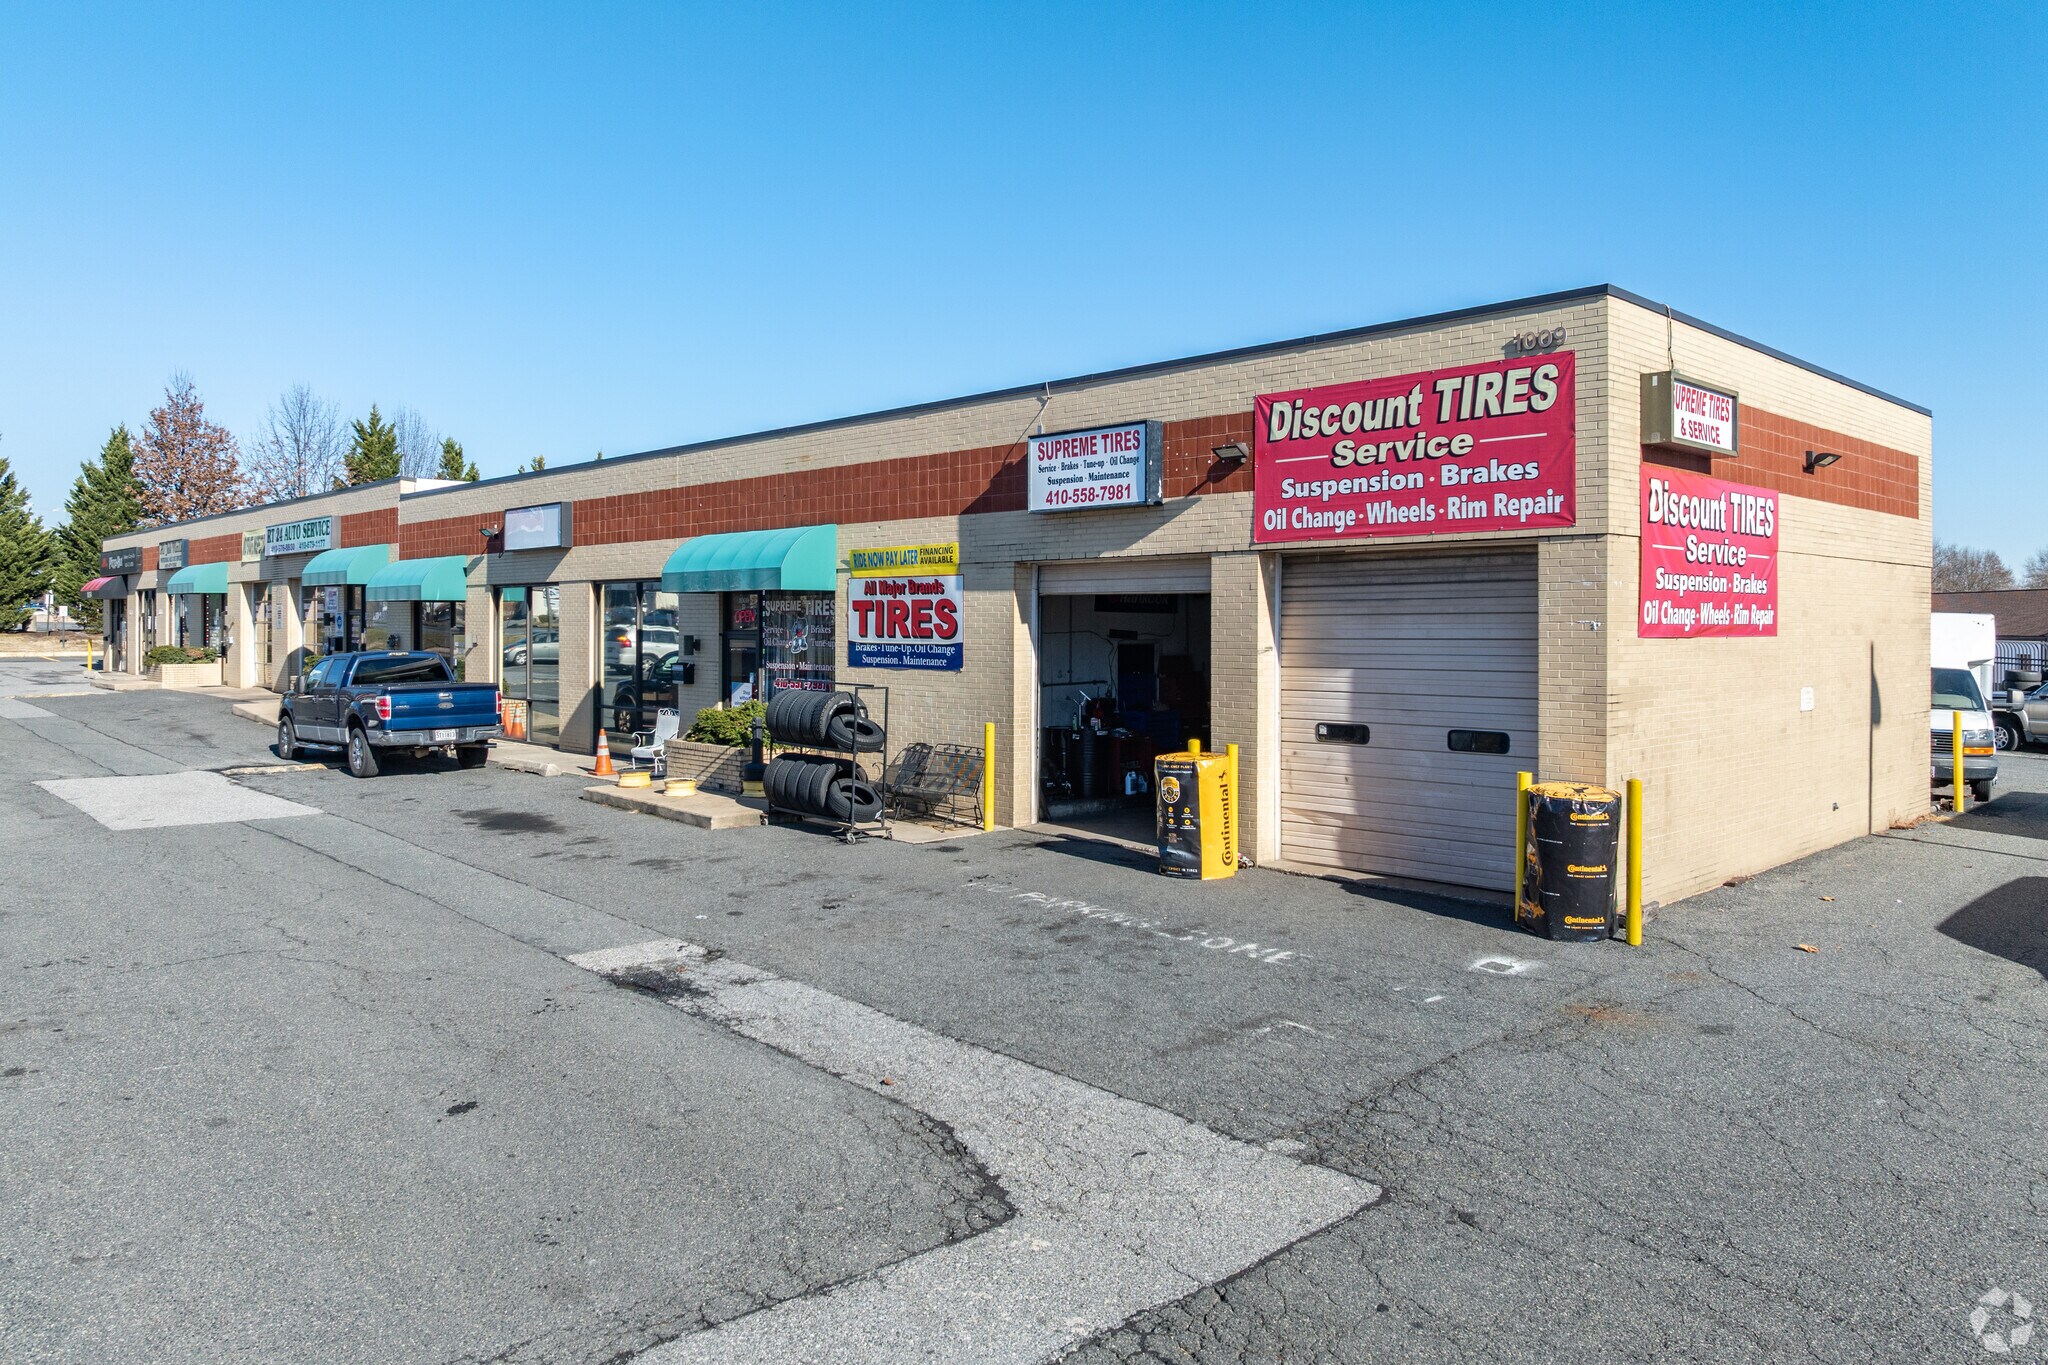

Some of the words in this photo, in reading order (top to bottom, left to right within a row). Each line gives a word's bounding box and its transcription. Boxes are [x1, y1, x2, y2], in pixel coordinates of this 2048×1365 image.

[1513, 326, 1568, 354] 1009
[1268, 382, 1424, 443] Discount
[1435, 364, 1560, 424] TIRES
[1674, 384, 1708, 417] UPREME
[1708, 394, 1730, 423] TIRES
[1680, 417, 1687, 437] &
[1688, 420, 1721, 445] SERVICE
[1037, 434, 1098, 462] SUPREME
[1101, 429, 1141, 454] TIRES
[1332, 431, 1475, 468] Service
[1037, 463, 1057, 474] Service
[1060, 460, 1079, 472] Brakes
[1083, 459, 1105, 470] Tune-up
[1109, 455, 1118, 467] Oil
[1119, 454, 1140, 467] Change
[1047, 473, 1084, 487] Suspension
[1088, 470, 1130, 483] Maintenance
[1281, 468, 1425, 502] Suspension
[1440, 458, 1540, 487] Brakes
[1045, 483, 1131, 506] 410-558-7981
[1263, 508, 1287, 532] Oil
[1291, 504, 1356, 534] Change
[1366, 497, 1436, 526] Wheels
[1447, 494, 1487, 520] Rim
[1493, 488, 1565, 524] Repair
[1648, 477, 1727, 533] Discount
[1729, 492, 1775, 538] TIRES
[275, 527, 283, 542] 24
[284, 524, 301, 541] AUTO
[302, 519, 330, 539] SERVICE
[852, 552, 867, 569] RIDE
[868, 551, 884, 567] NOW
[885, 550, 899, 567] PAY
[899, 549, 919, 566] LATER
[919, 546, 954, 556] FINANCING
[920, 555, 954, 565] AVAILABLE
[1685, 534, 1747, 568] Service
[863, 580, 878, 596] All
[878, 580, 907, 599] Major
[907, 578, 945, 596] Brands
[1655, 567, 1727, 597] Suspension
[1732, 572, 1768, 595] Brakes
[734, 609, 756, 623] OPEN
[765, 599, 802, 617] SUPREME
[805, 599, 835, 616] TIRES
[852, 598, 959, 640] TIRES
[1643, 599, 1659, 626] Oil
[1660, 600, 1696, 632] Change
[1700, 601, 1731, 626] Wheels
[1733, 603, 1750, 626] Rim
[1751, 603, 1775, 632] Repair
[763, 625, 784, 634] Service
[810, 624, 832, 634] Brakes
[855, 643, 877, 652] Brakes
[880, 643, 913, 655] Tune-Up
[914, 643, 926, 653] Oil
[927, 643, 956, 656] Change
[862, 654, 899, 667] Suspension
[902, 655, 947, 667] Maintenance
[765, 660, 796, 672] Suspension
[1219, 783, 1234, 866] Continental
[1569, 812, 1606, 821] Continental
[1567, 864, 1604, 873] Continental
[1564, 915, 1601, 924] Continental
